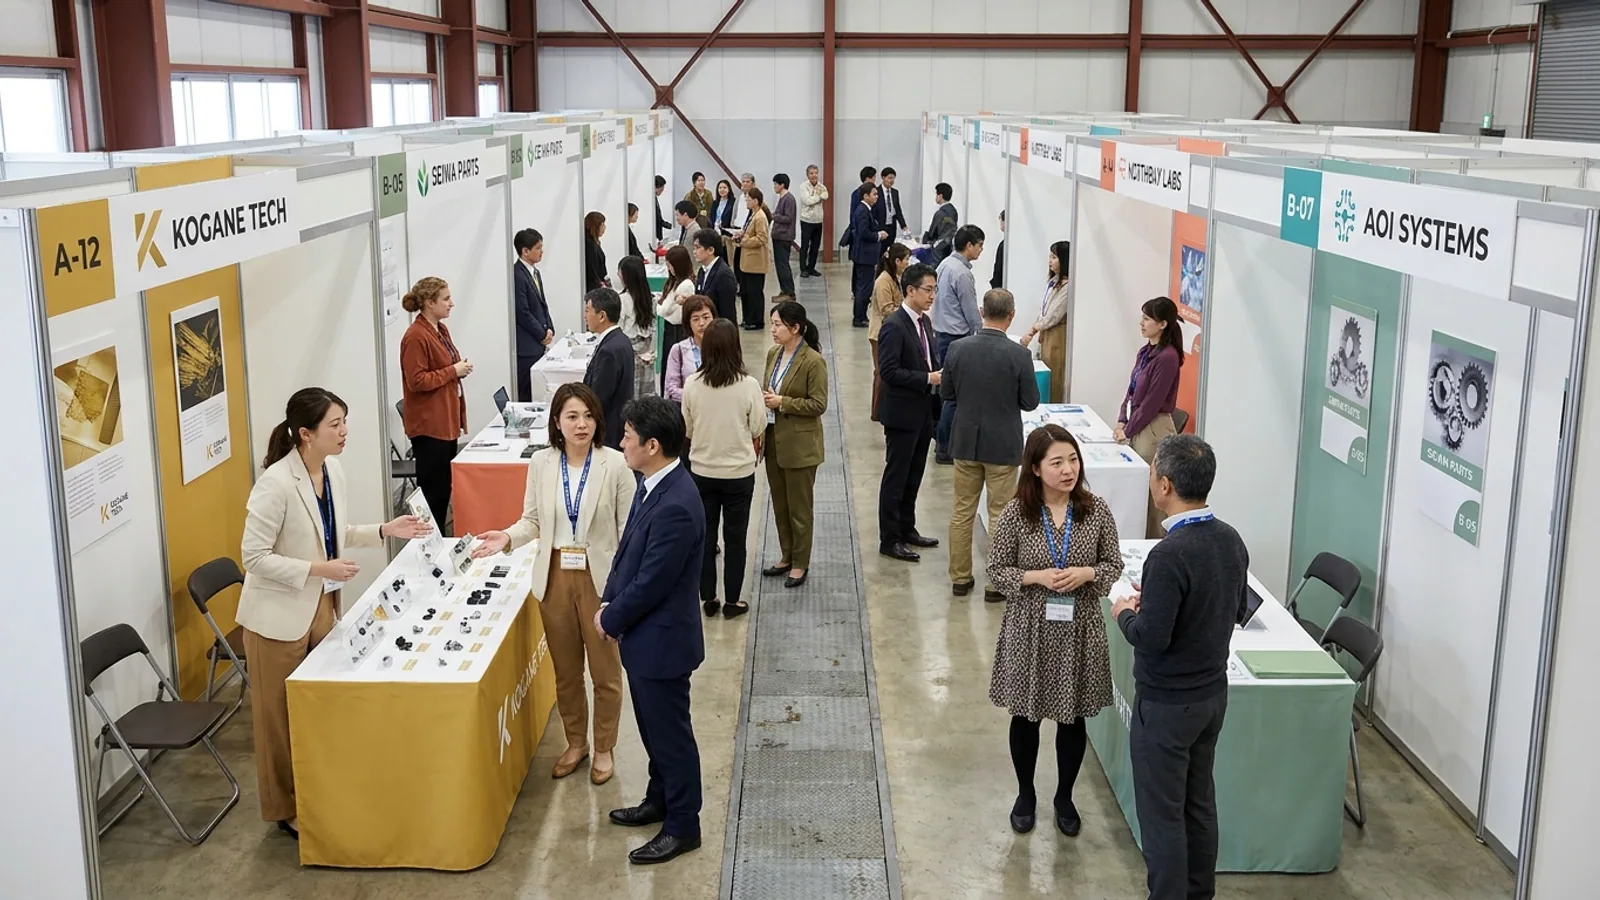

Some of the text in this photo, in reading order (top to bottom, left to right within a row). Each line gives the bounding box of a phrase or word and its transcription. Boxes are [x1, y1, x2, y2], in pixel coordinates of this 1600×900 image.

[383, 173, 403, 195] B-05
[432, 157, 480, 186] SEIWA PARTS
[172, 197, 287, 249] KOGANE TECH
[1286, 193, 1315, 220] B-07
[1363, 207, 1489, 261] AOI SYSTEMS
[54, 236, 101, 276] A-12
